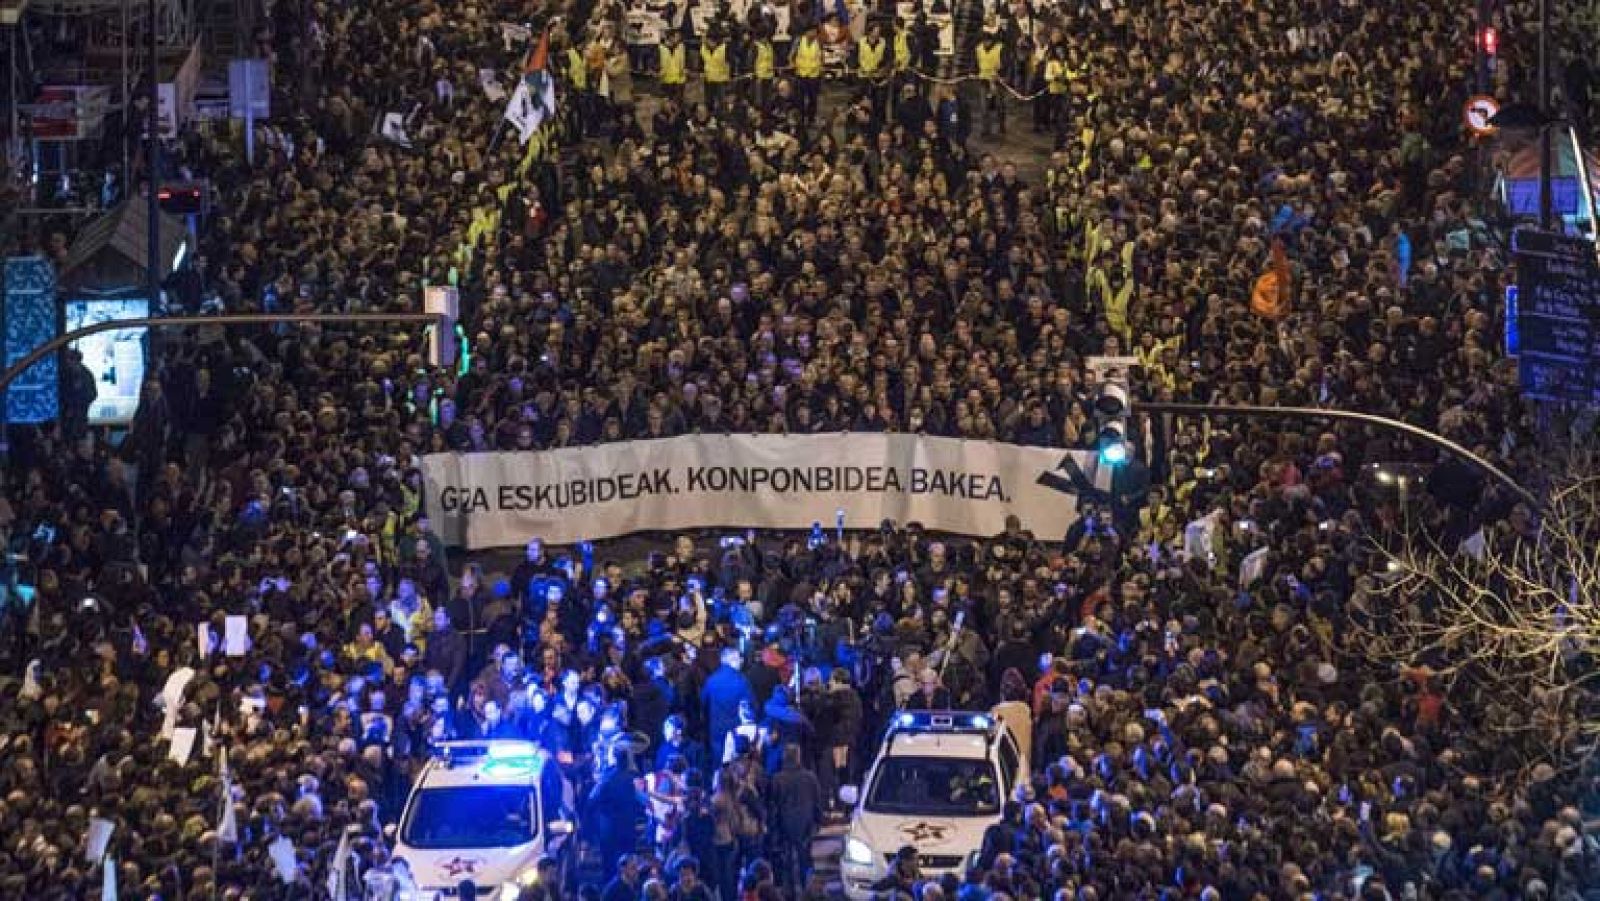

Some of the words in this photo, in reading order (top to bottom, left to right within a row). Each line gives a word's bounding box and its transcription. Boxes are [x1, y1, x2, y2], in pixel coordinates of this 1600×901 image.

[497, 468, 680, 510] ESKUBIDEAK.
[687, 466, 905, 494] KONPONBIDEA.
[910, 468, 1012, 503] BAKEA.
